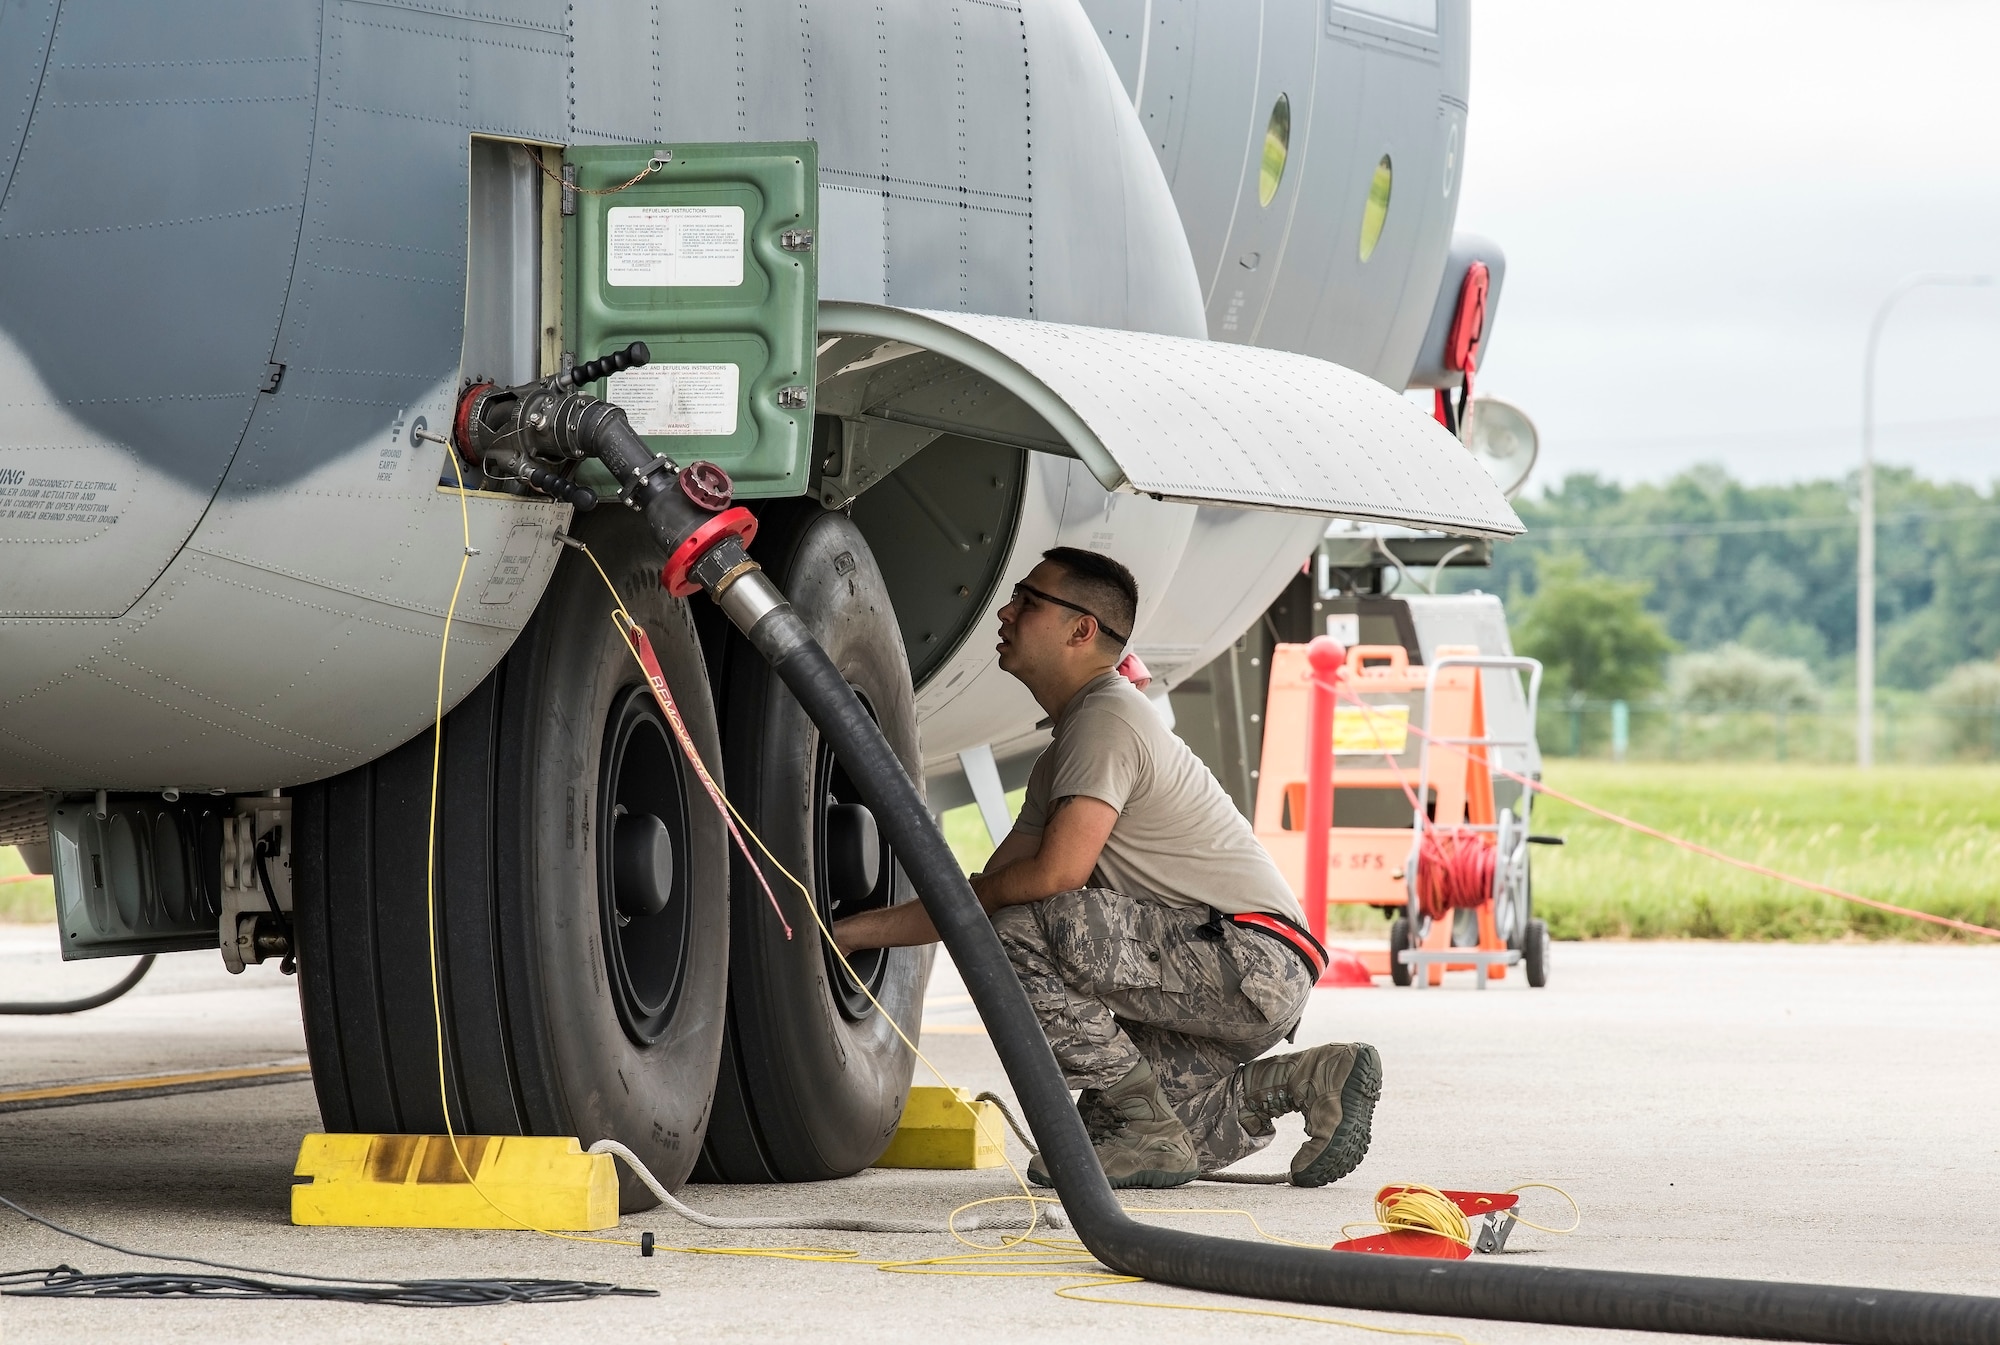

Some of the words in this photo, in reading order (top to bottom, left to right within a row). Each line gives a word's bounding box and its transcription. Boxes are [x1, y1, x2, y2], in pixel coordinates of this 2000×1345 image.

[380, 448, 402, 458] GROUND
[378, 460, 398, 470] EARTH
[376, 472, 393, 481] HERE
[28, 478, 73, 489] DISCONNECT
[74, 480, 117, 491] ELECTRICAL
[19, 488, 40, 498] DOOR
[41, 490, 79, 500] ACTUATOR
[80, 492, 96, 501] AND
[13, 499, 45, 509] COCKPIT
[55, 502, 75, 511] OPEN
[76, 504, 109, 513] POSITION
[17, 511, 36, 520] AREA
[38, 512, 65, 521] BEHIND
[66, 513, 97, 523] SPOILER
[97, 515, 119, 524] DOOR
[1350, 853, 1384, 869] SFS
